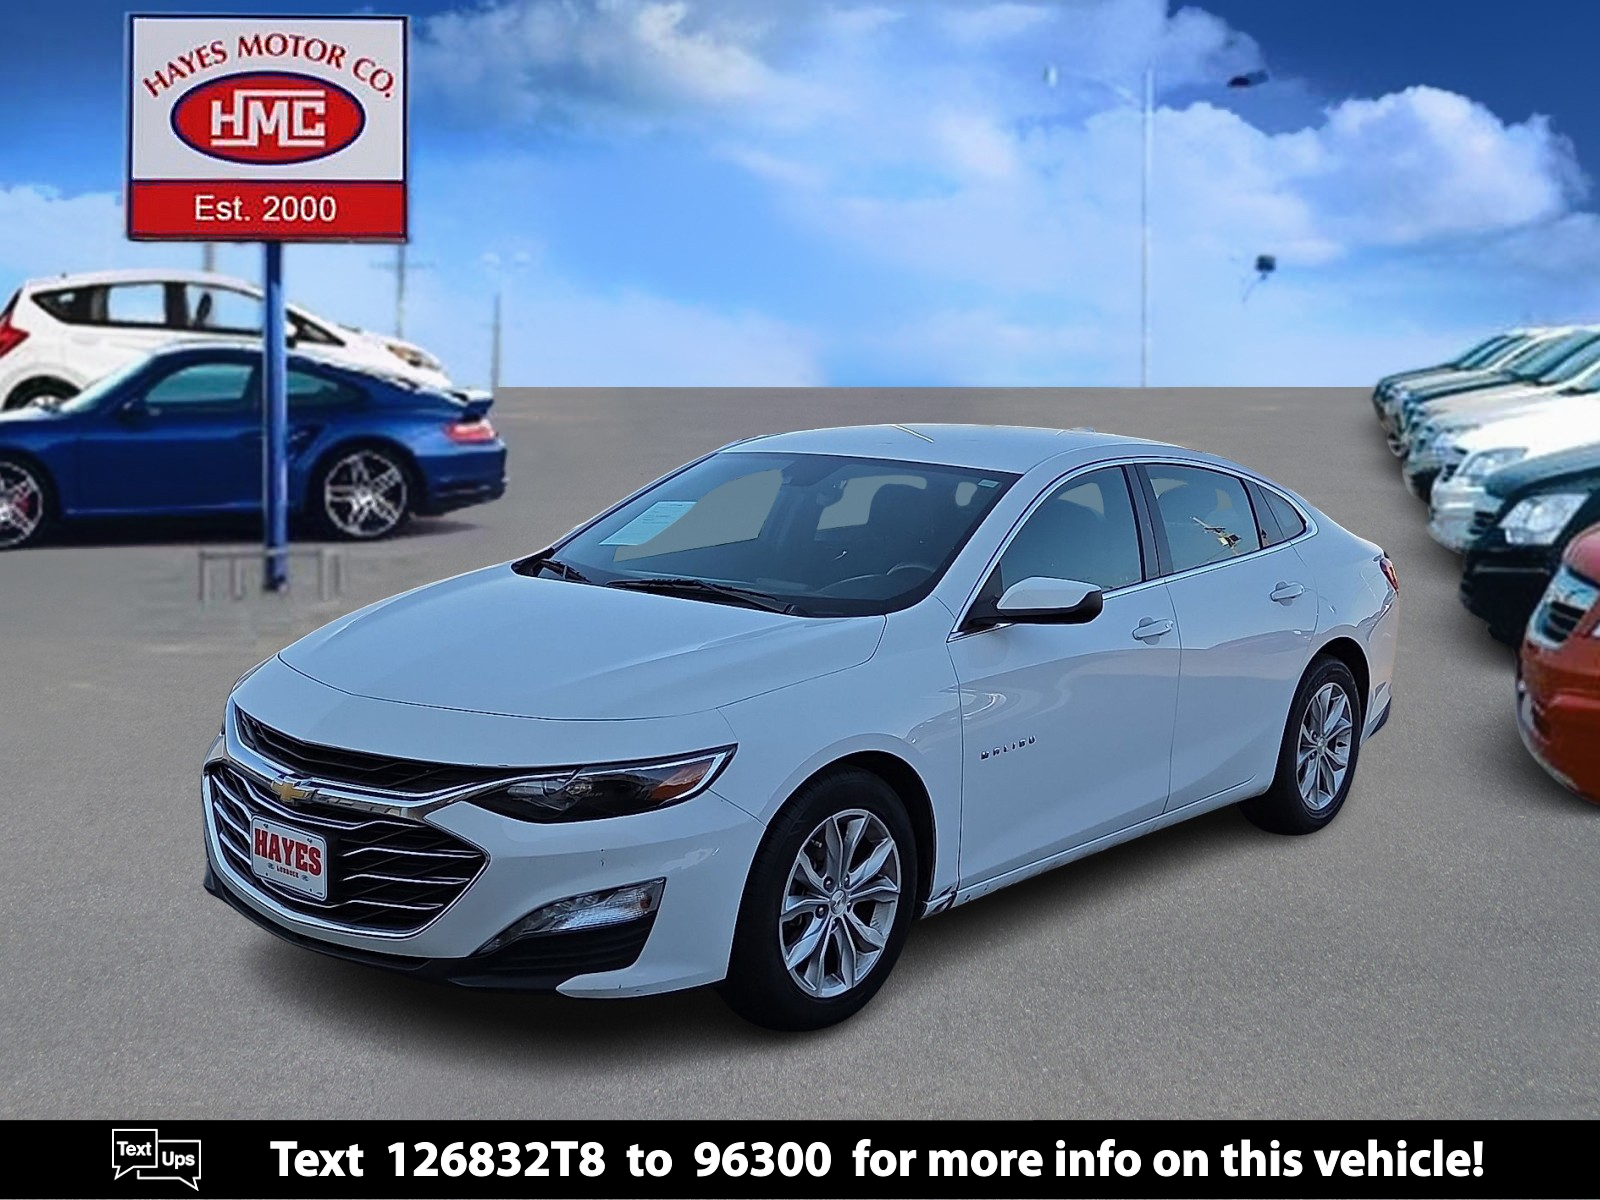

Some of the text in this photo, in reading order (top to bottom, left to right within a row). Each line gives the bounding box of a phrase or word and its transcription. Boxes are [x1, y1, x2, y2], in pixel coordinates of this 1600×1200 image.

[142, 32, 395, 99] HAYES MOTOR CO.
[210, 88, 326, 147] HMC
[194, 194, 337, 223] Est. 2000
[254, 827, 322, 876] HAYES
